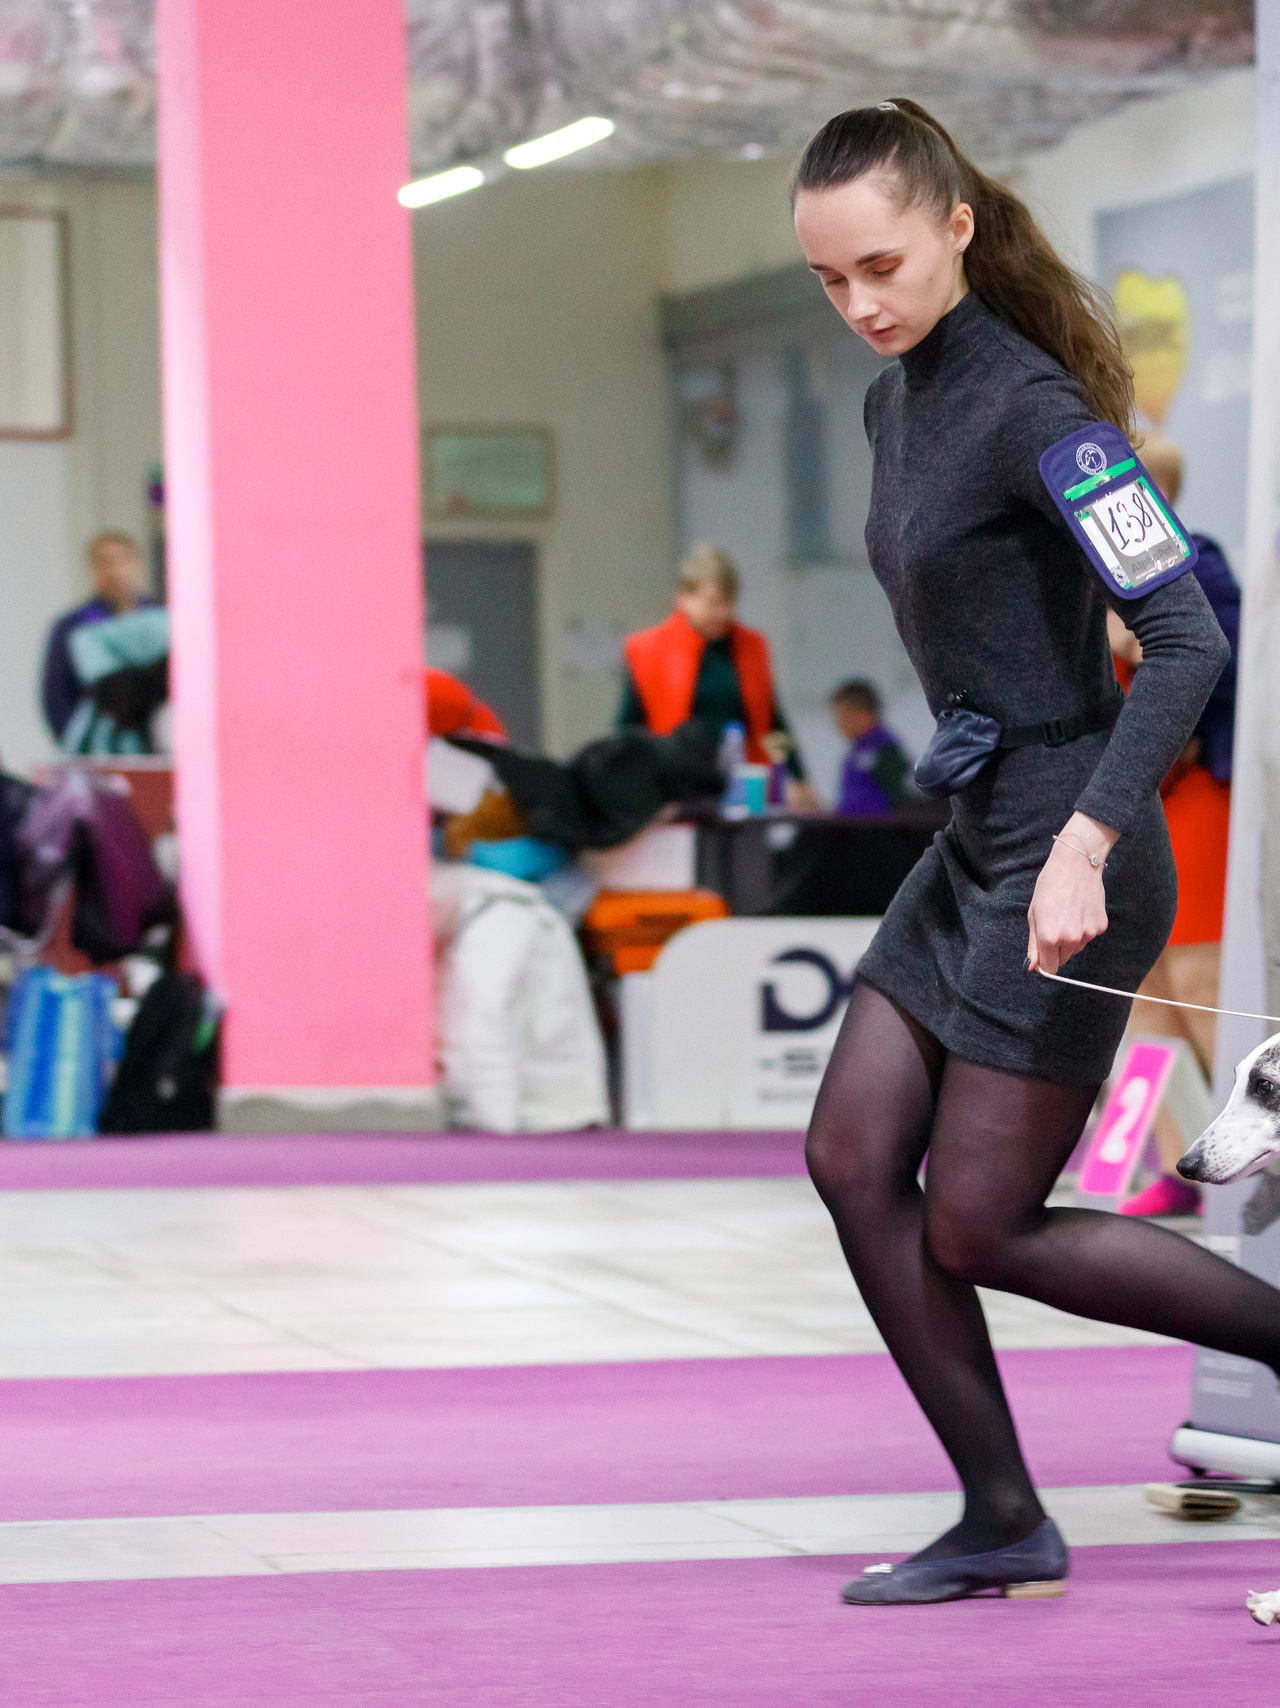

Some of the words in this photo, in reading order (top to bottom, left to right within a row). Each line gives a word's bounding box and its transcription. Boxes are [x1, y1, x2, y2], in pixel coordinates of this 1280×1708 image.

[1107, 492, 1154, 551] 138
[1131, 544, 1174, 574] AlphaPet
[1099, 1075, 1150, 1164] 2
